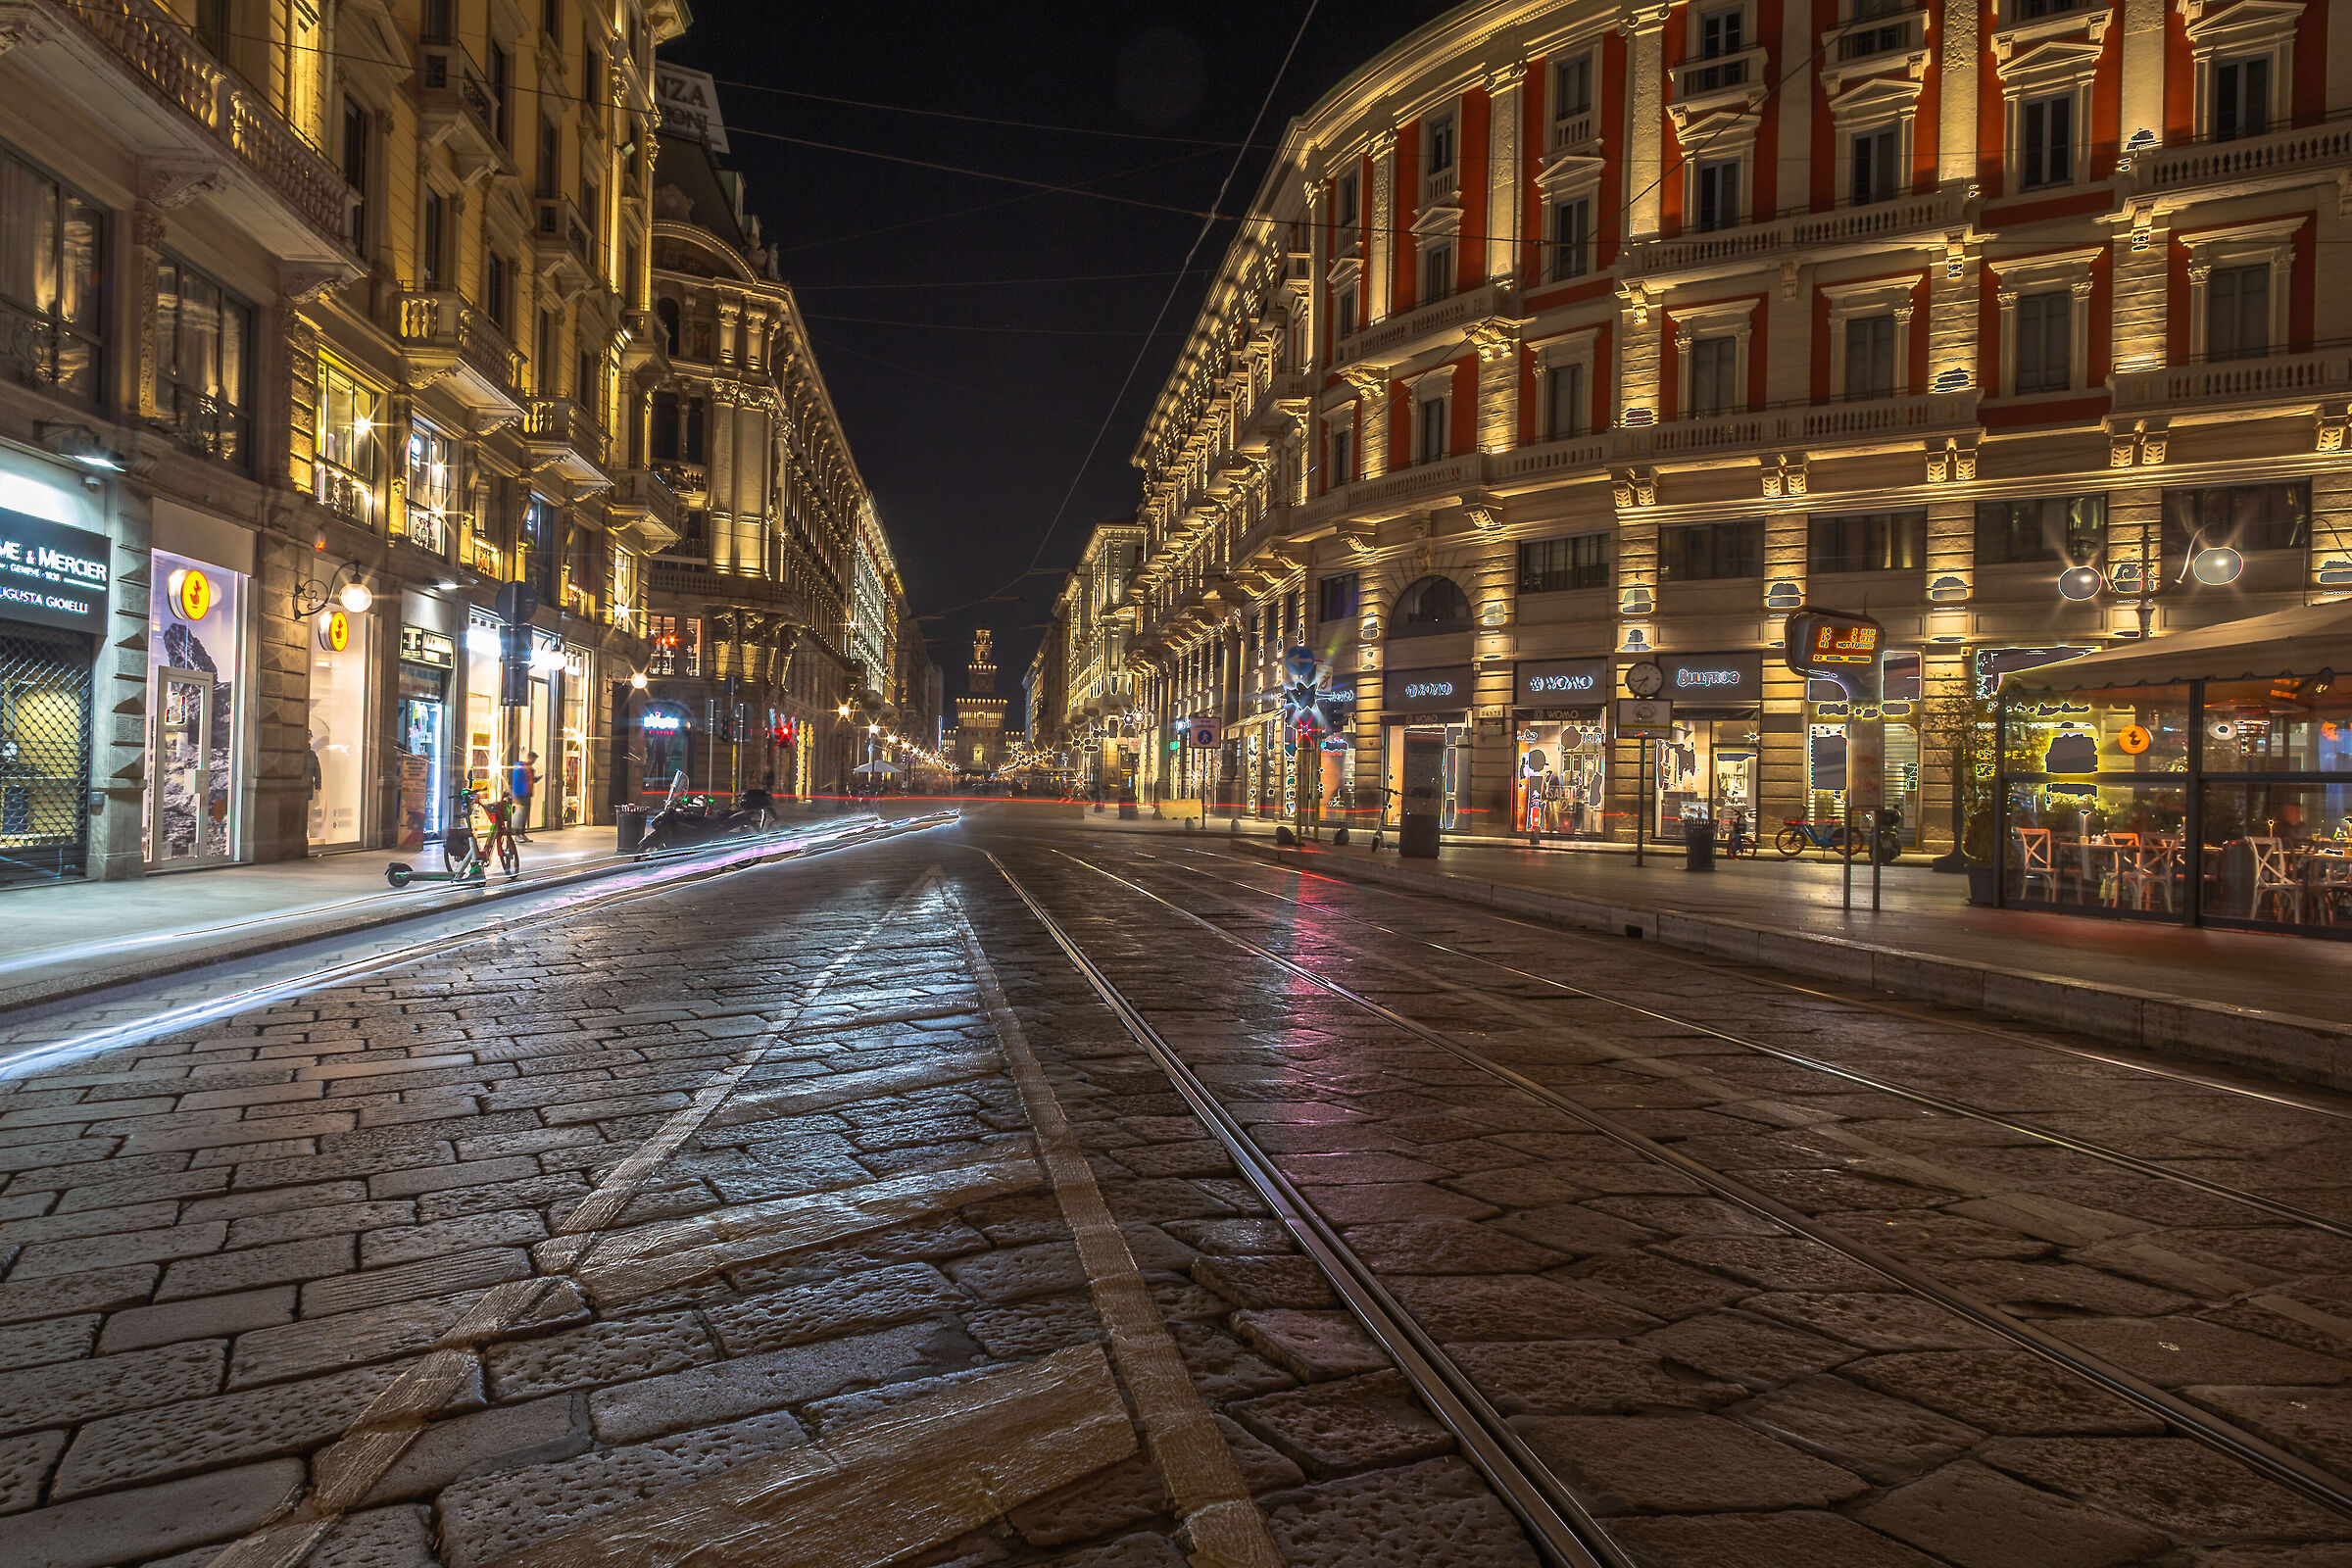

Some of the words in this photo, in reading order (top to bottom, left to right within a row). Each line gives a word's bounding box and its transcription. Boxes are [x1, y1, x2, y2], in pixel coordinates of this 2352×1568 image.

[24, 550, 36, 565] &
[38, 546, 107, 582] MERCIER
[45, 595, 88, 614] GIOIELLI
[1545, 676, 1593, 690] WOMO
[1677, 669, 1740, 687] BULLFROG
[1547, 710, 1579, 719] WOMO
[1548, 787, 1575, 800] SALDI
